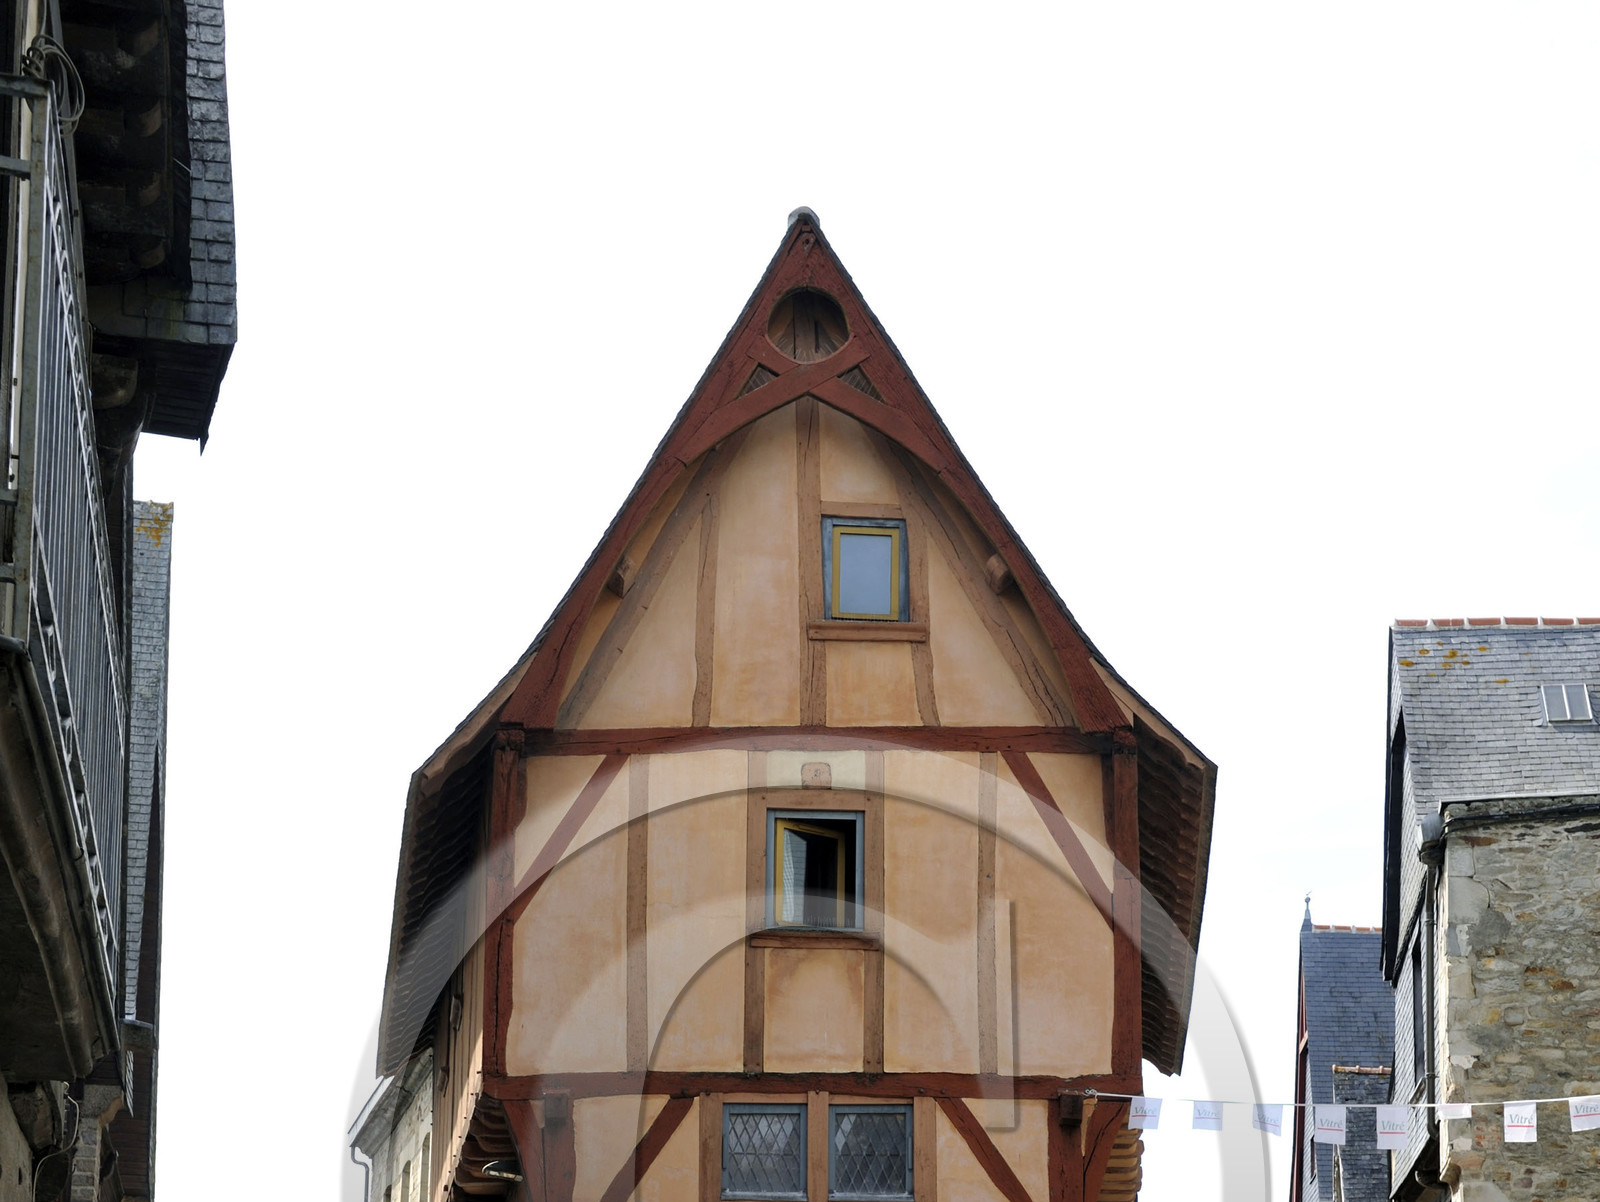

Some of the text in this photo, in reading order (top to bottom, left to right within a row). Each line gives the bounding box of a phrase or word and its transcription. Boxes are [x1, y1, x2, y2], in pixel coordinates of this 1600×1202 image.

[1574, 1104, 1599, 1114] Vitré
[1319, 1118, 1343, 1128] Vitré
[1509, 1113, 1534, 1124] Vitré
[1381, 1120, 1405, 1130] Vitré
